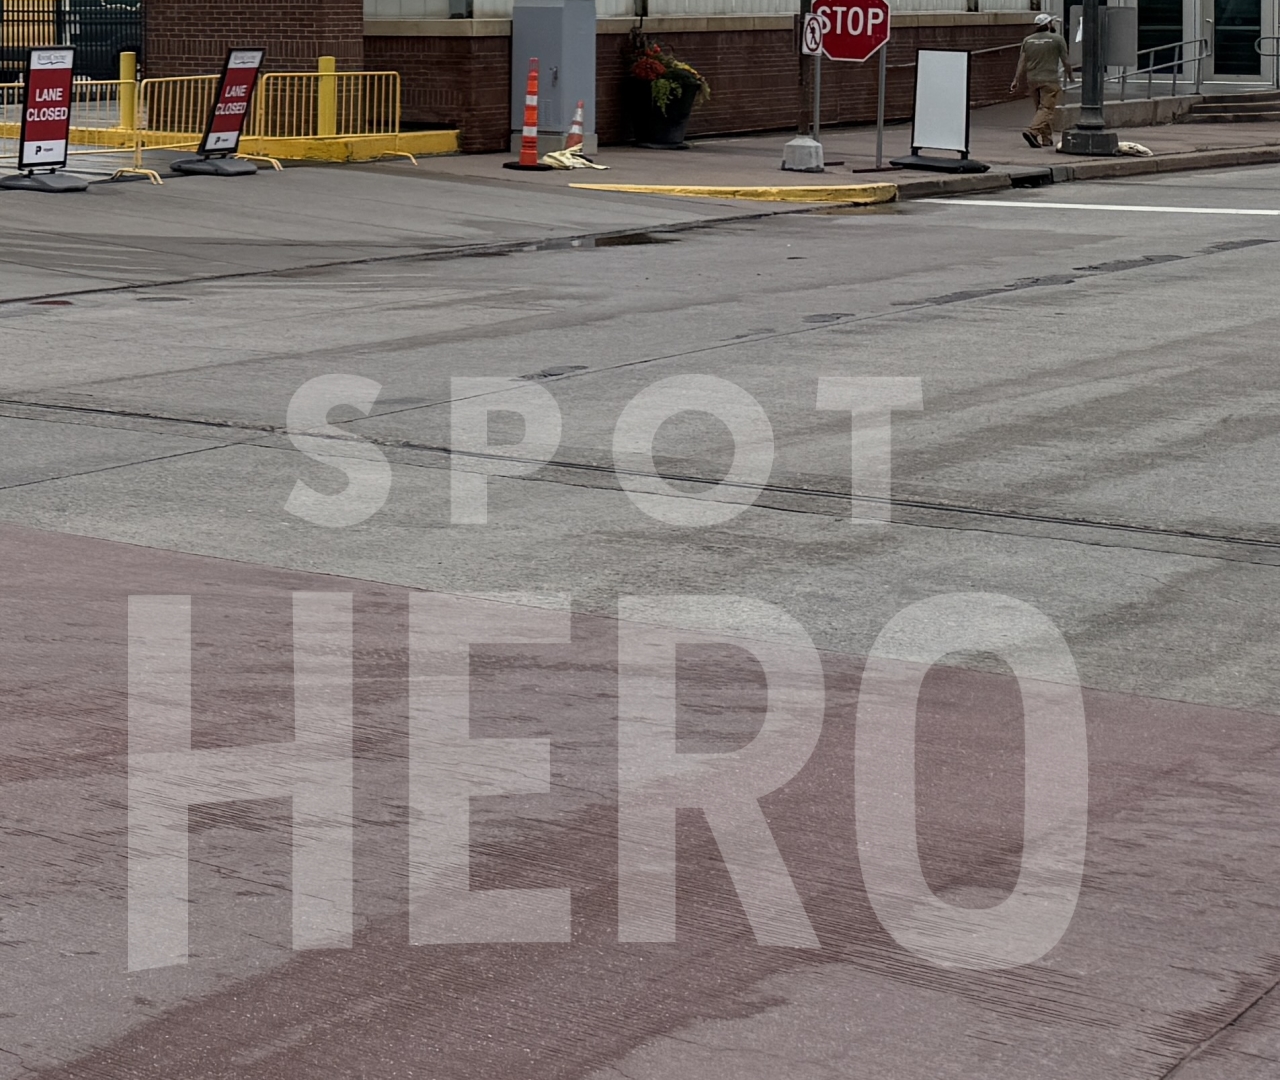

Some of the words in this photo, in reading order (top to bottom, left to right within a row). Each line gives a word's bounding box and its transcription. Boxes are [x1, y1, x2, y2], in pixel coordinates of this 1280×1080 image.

[817, 5, 884, 36] STOP
[35, 88, 63, 102] LANE
[224, 85, 248, 97] LANE
[26, 107, 68, 121] CLOSED
[214, 102, 248, 115] CLOSED
